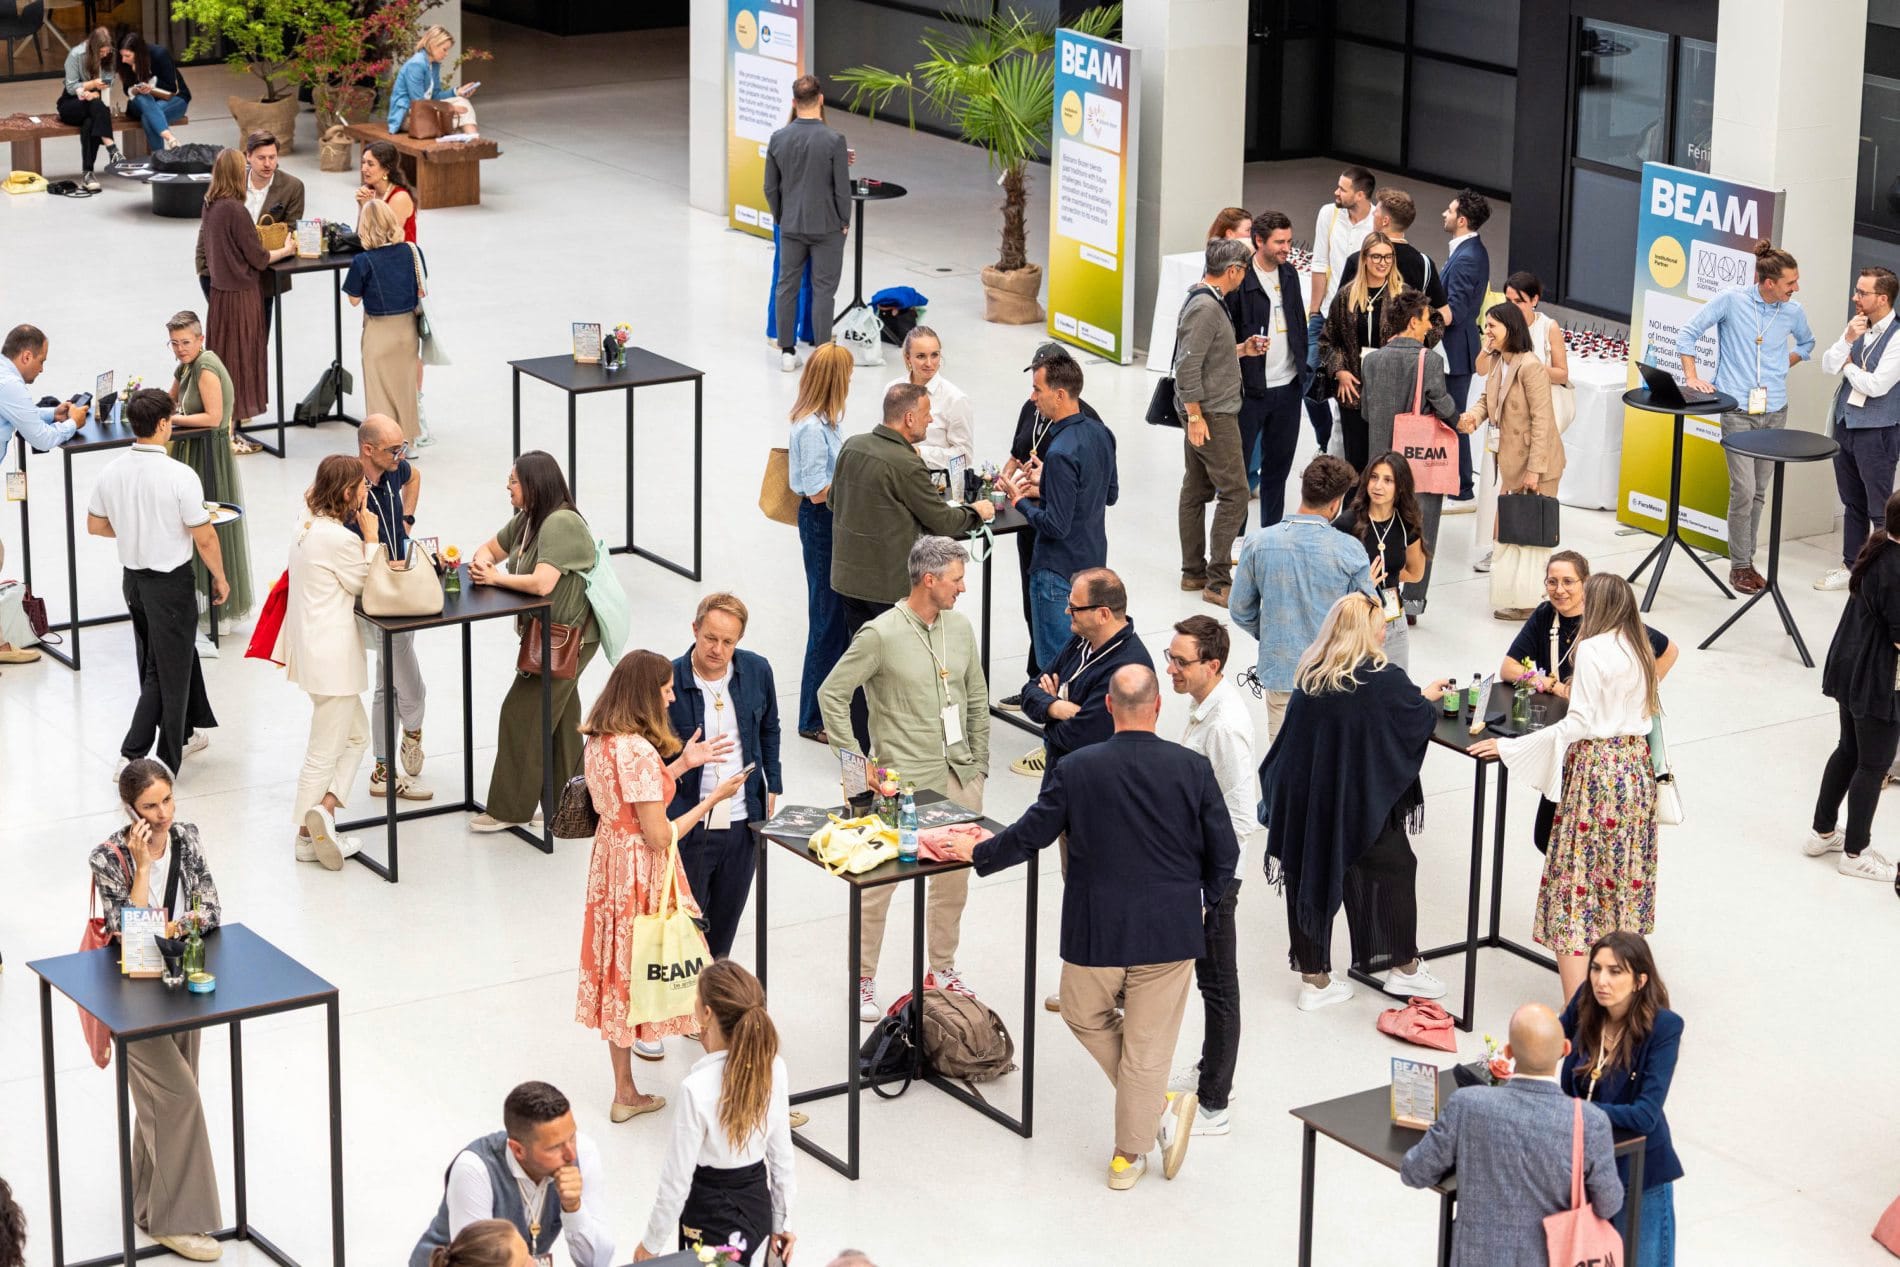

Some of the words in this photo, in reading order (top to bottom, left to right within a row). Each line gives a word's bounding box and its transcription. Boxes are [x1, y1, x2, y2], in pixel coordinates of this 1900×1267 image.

[1061, 39, 1123, 90] BEAM
[1651, 178, 1758, 240] BEAM
[1654, 254, 1678, 264] Institutional
[1654, 260, 1668, 268] Partner
[1648, 320, 1662, 330] NOI
[1662, 324, 1680, 334] embo
[1656, 333, 1676, 346] innova
[1694, 346, 1714, 356] rough
[1654, 346, 1674, 356] actical
[1702, 360, 1716, 368] and
[1404, 446, 1447, 460] BEAM
[841, 750, 864, 768] BEAM
[124, 910, 164, 922] BEAM
[647, 956, 704, 982] BEAM
[1394, 1060, 1435, 1078] BEAM
